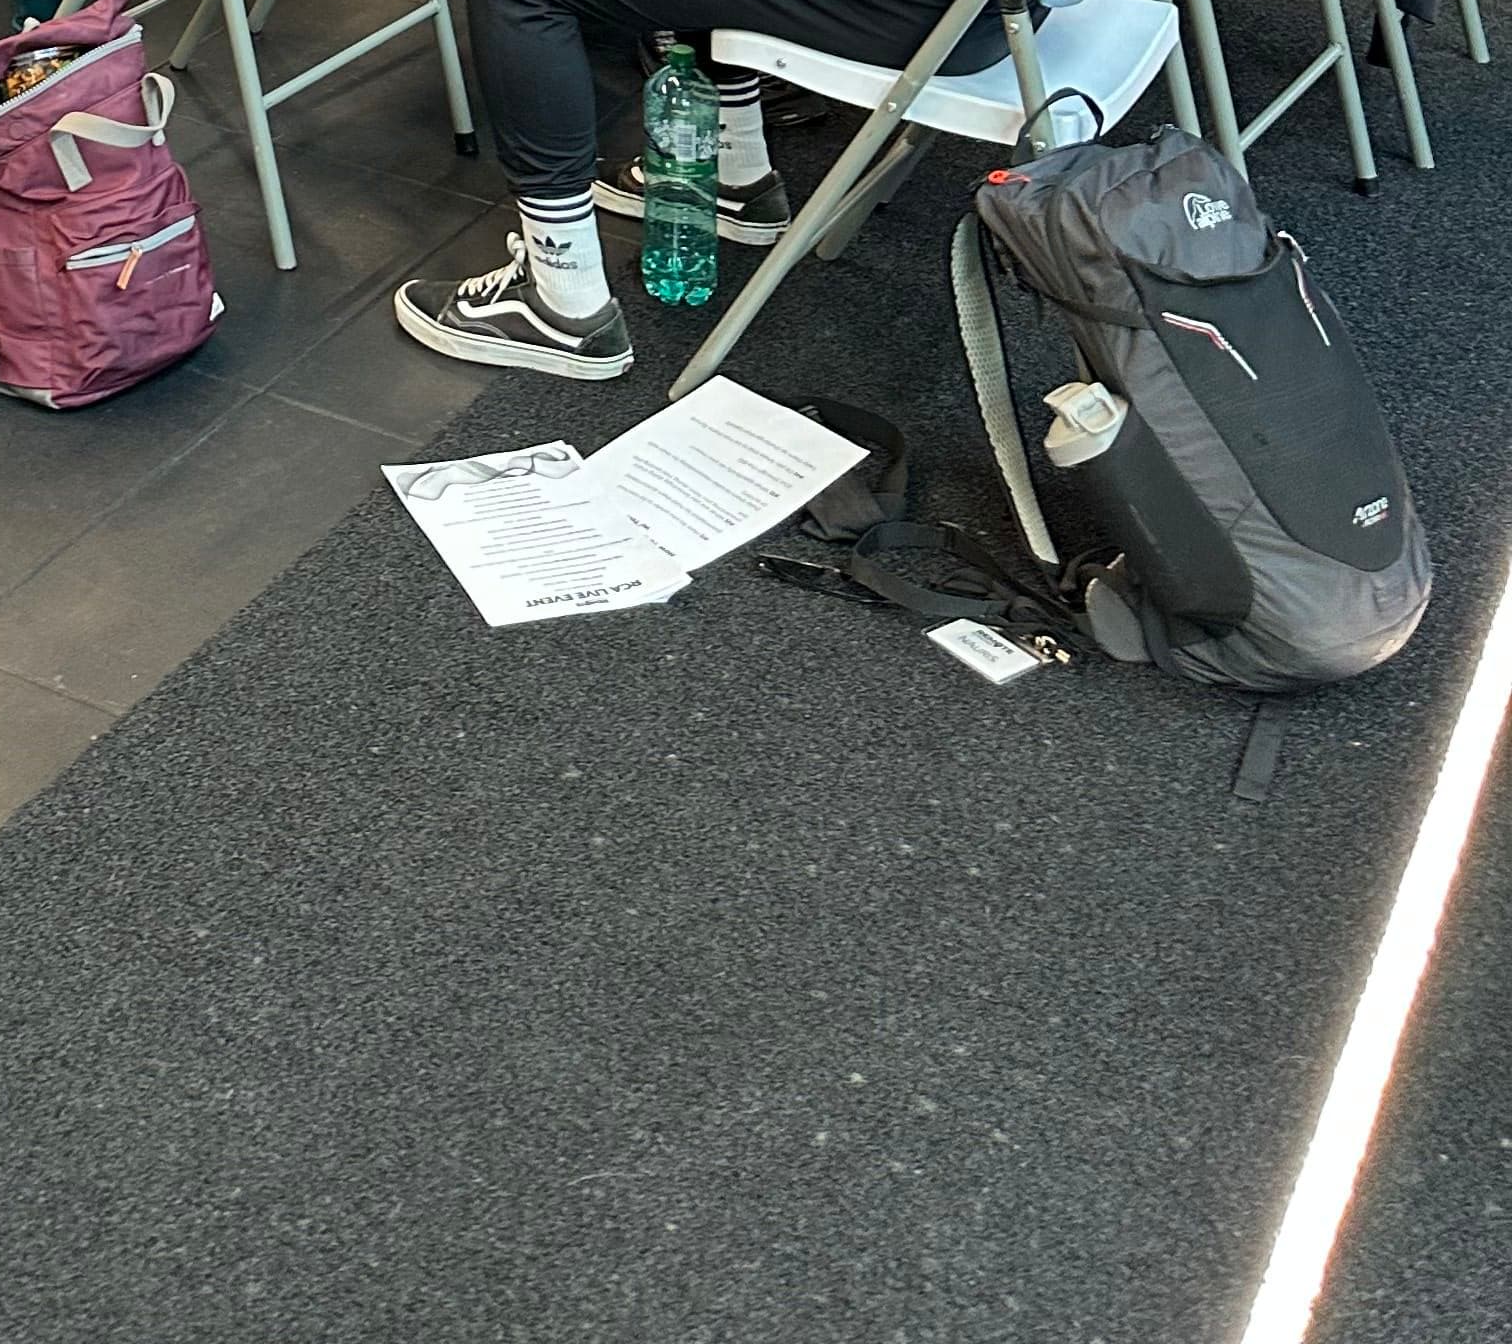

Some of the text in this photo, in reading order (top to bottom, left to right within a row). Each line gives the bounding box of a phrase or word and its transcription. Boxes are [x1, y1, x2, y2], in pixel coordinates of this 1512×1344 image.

[608, 579, 643, 593] RCA
[525, 592, 574, 608] EVENT
[574, 587, 610, 600] LIVE
